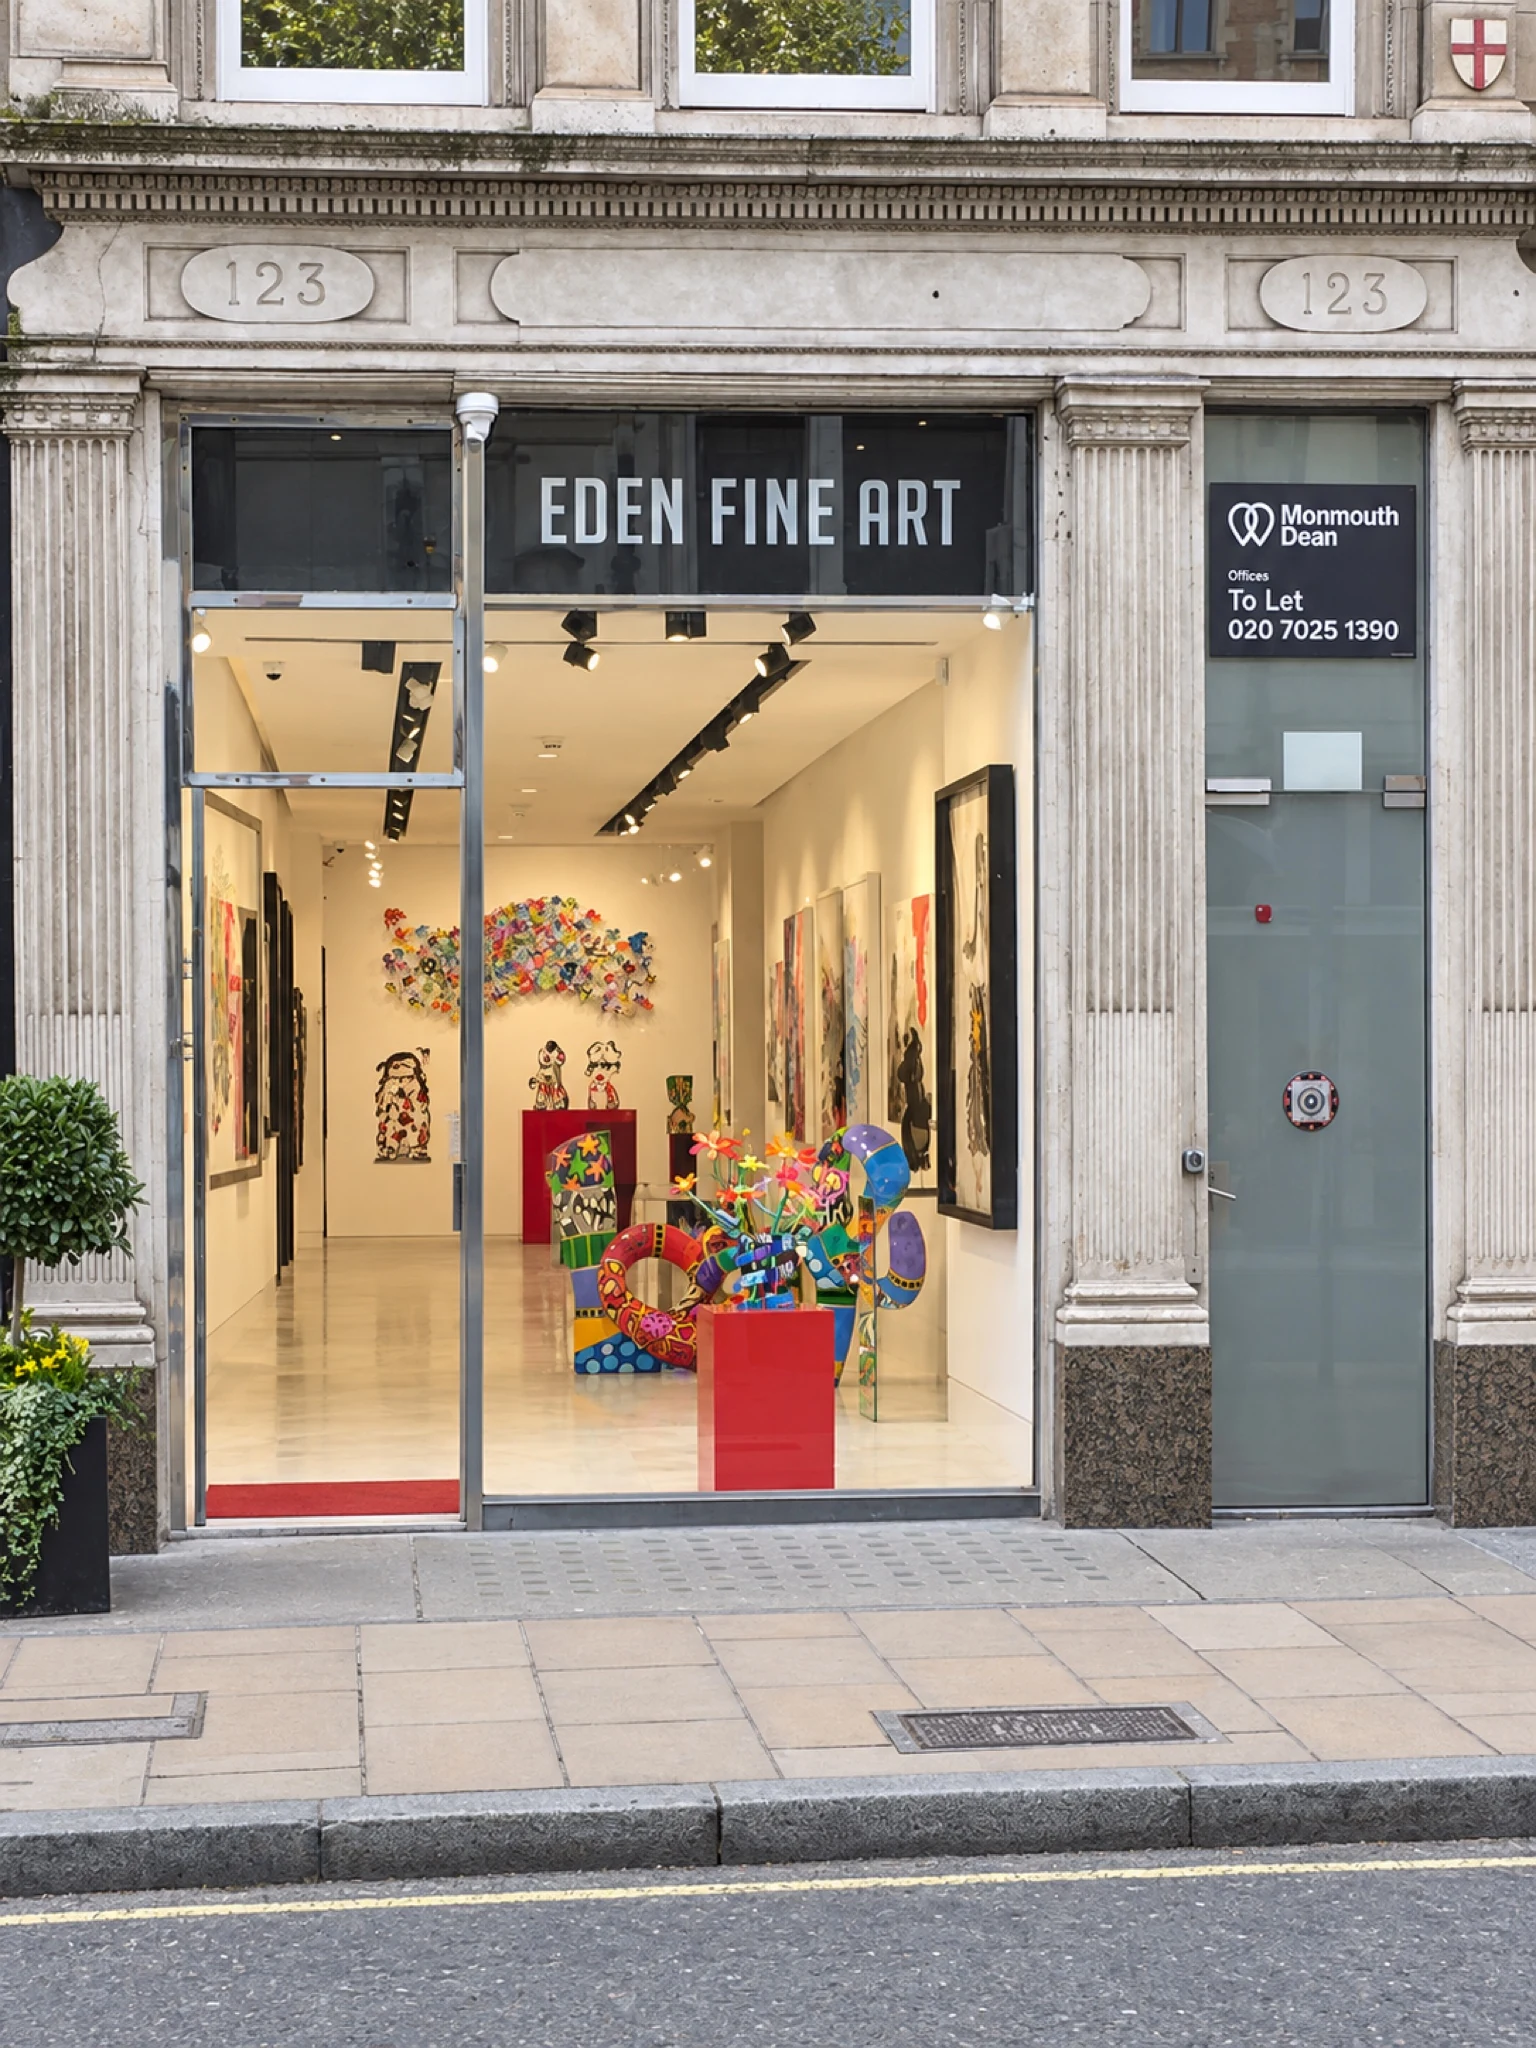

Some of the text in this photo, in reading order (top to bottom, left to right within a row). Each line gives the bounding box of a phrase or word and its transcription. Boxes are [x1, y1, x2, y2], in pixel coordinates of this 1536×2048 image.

[226, 261, 326, 306] 123
[1302, 272, 1388, 315] 123
[541, 477, 961, 546] EDEN FINE ART
[1281, 504, 1400, 526] Monmouth
[1281, 526, 1338, 546] Dean
[1228, 570, 1270, 582] Offices
[1228, 588, 1304, 611] To Let
[1228, 619, 1399, 641] 020 7025 1390
